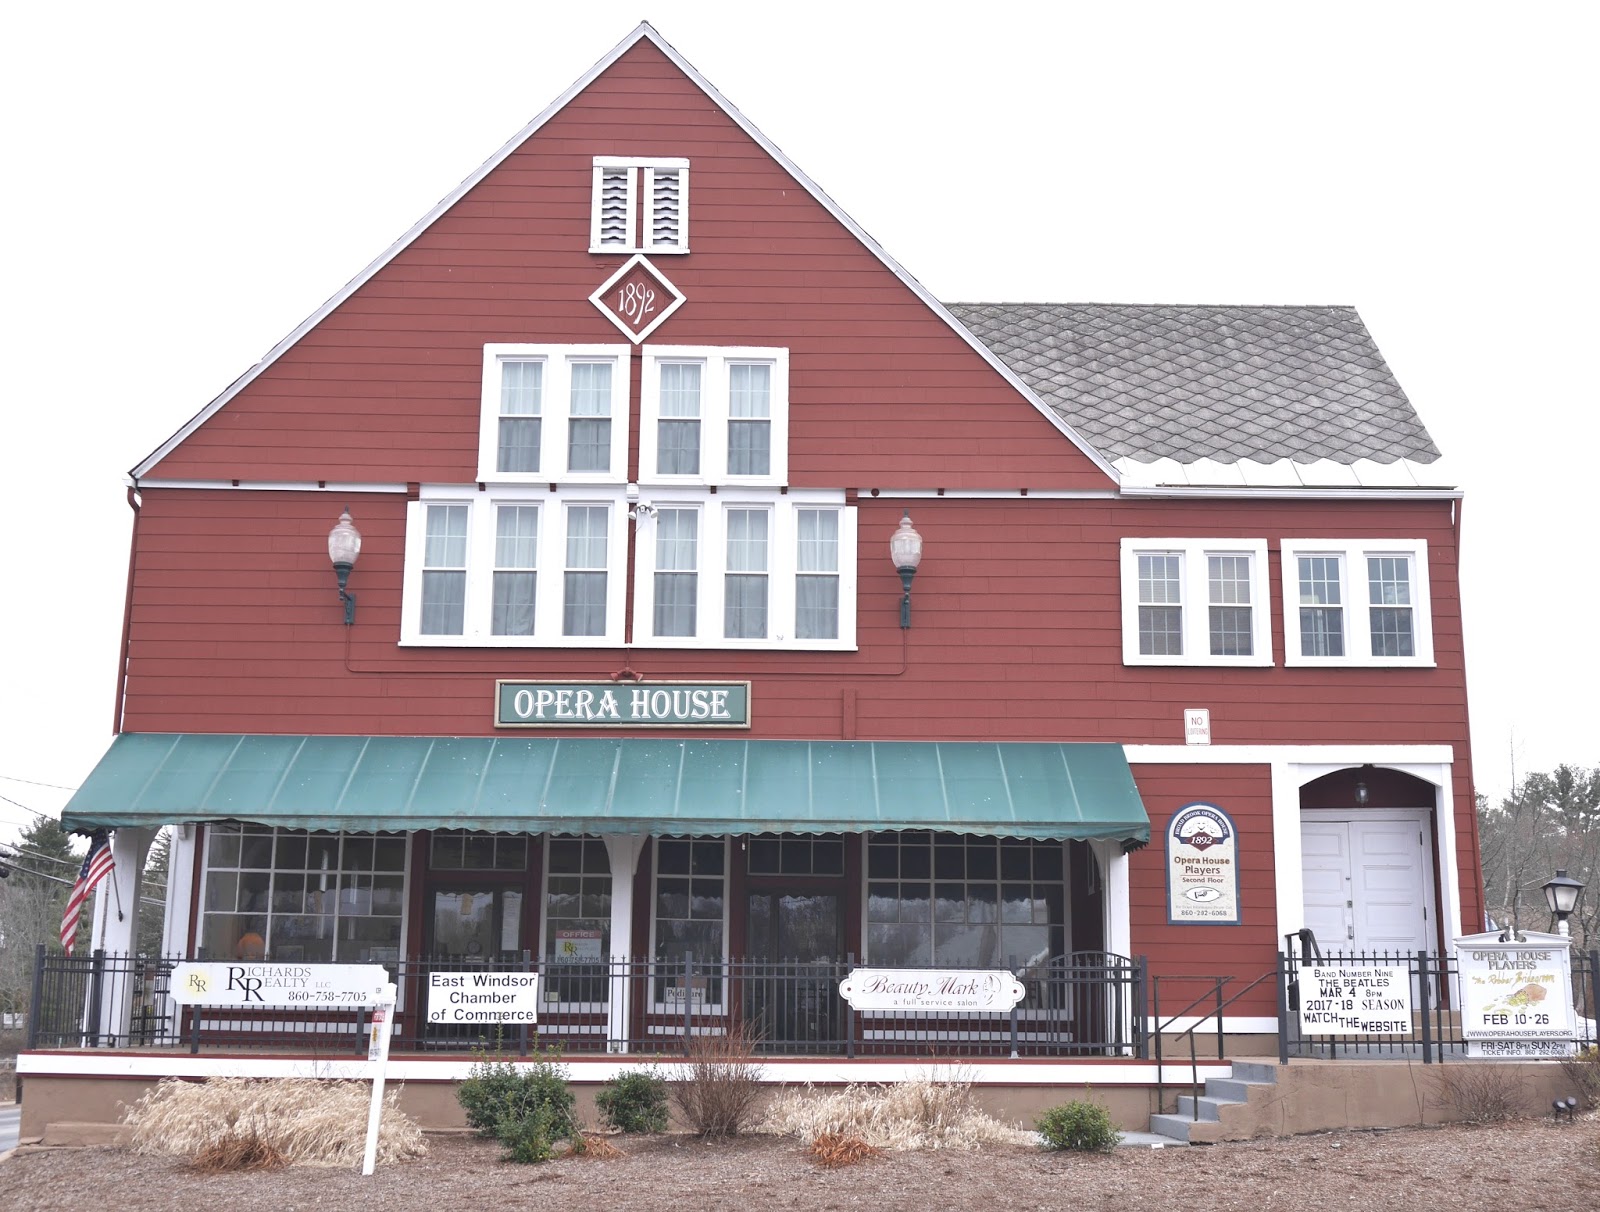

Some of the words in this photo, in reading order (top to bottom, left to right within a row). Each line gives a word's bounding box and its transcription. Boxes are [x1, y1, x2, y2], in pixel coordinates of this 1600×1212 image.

[619, 282, 655, 325] 1892
[514, 689, 621, 721] OPERA
[631, 689, 731, 720] HOUSE
[1191, 716, 1203, 726] NO
[1201, 810, 1219, 822] OPERA
[1190, 836, 1213, 845] 1892
[1174, 856, 1201, 866] Opera
[1202, 856, 1231, 865] House
[1185, 865, 1221, 876] Players
[1472, 951, 1510, 961] OPERA
[1516, 951, 1552, 961] HOUSE
[1488, 960, 1538, 971] PLAYERS
[1314, 969, 1337, 978] BAND
[1339, 969, 1373, 978] NUMBER
[1374, 969, 1394, 978] NINE
[315, 981, 331, 989] LLC
[431, 974, 465, 987] East
[473, 974, 535, 987] Windsor
[1319, 979, 1340, 987] THE
[1343, 979, 1390, 987] BEATLES
[862, 974, 930, 999] Beauty
[928, 976, 979, 996] Mark
[288, 991, 367, 1002] 860-758-7705
[449, 991, 517, 1004] Chamber
[1320, 987, 1342, 998] MAR
[1348, 987, 1356, 998] 4
[1365, 989, 1383, 998] 8PM
[903, 998, 917, 1006] full
[1361, 999, 1405, 1011] SEASON
[431, 1008, 447, 1021] of
[454, 1008, 534, 1021] Commerce
[1483, 1014, 1509, 1025] FEB
[1303, 1012, 1338, 1023] WATCH
[1339, 1017, 1360, 1028] THE
[1361, 1021, 1407, 1032] WEBSITE
[1481, 1041, 1515, 1050] FRI-SAT
[1531, 1041, 1551, 1050] SUN
